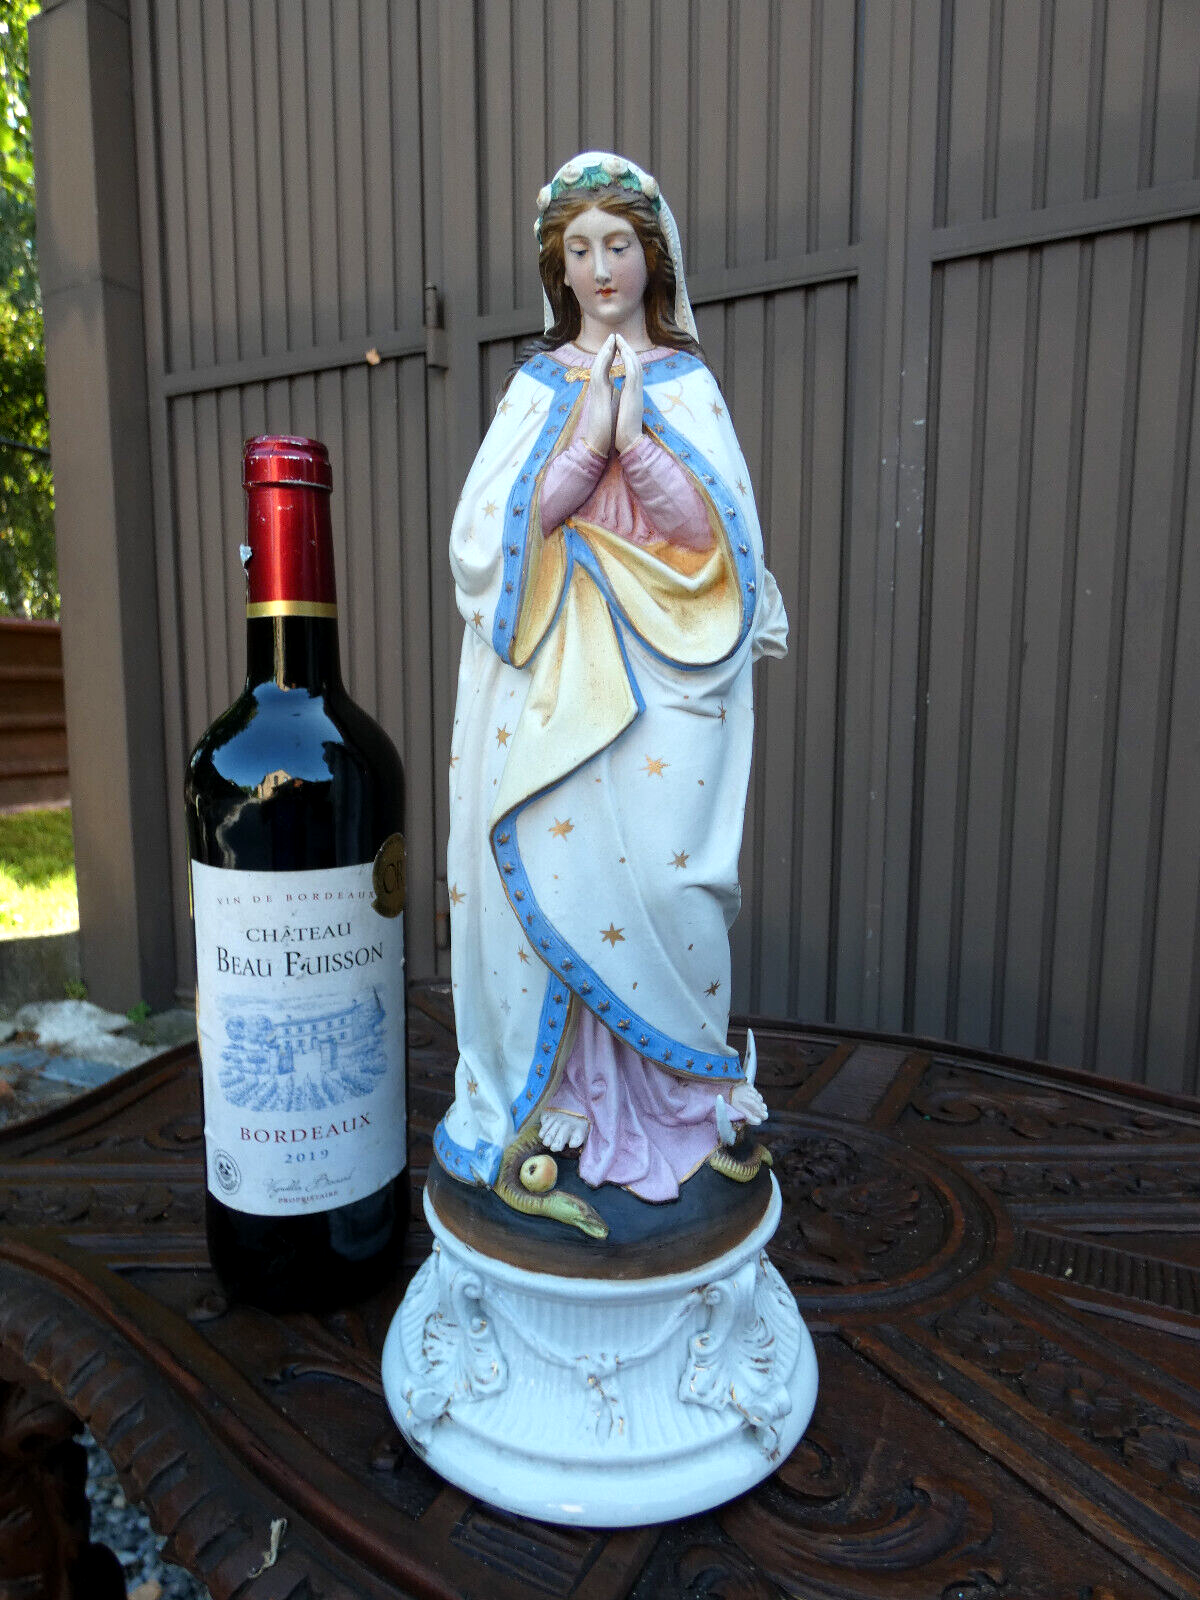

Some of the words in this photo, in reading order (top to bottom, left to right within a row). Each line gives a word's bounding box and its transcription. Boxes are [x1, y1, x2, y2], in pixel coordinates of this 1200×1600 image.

[217, 895, 242, 906] VIN
[252, 894, 274, 905] DE
[286, 889, 376, 903] BORDEAUX
[246, 922, 352, 943] CHÂTEAU
[216, 945, 273, 978] BEAU
[240, 1112, 372, 1144] BORDEAUX
[284, 1149, 330, 1165] 2019
